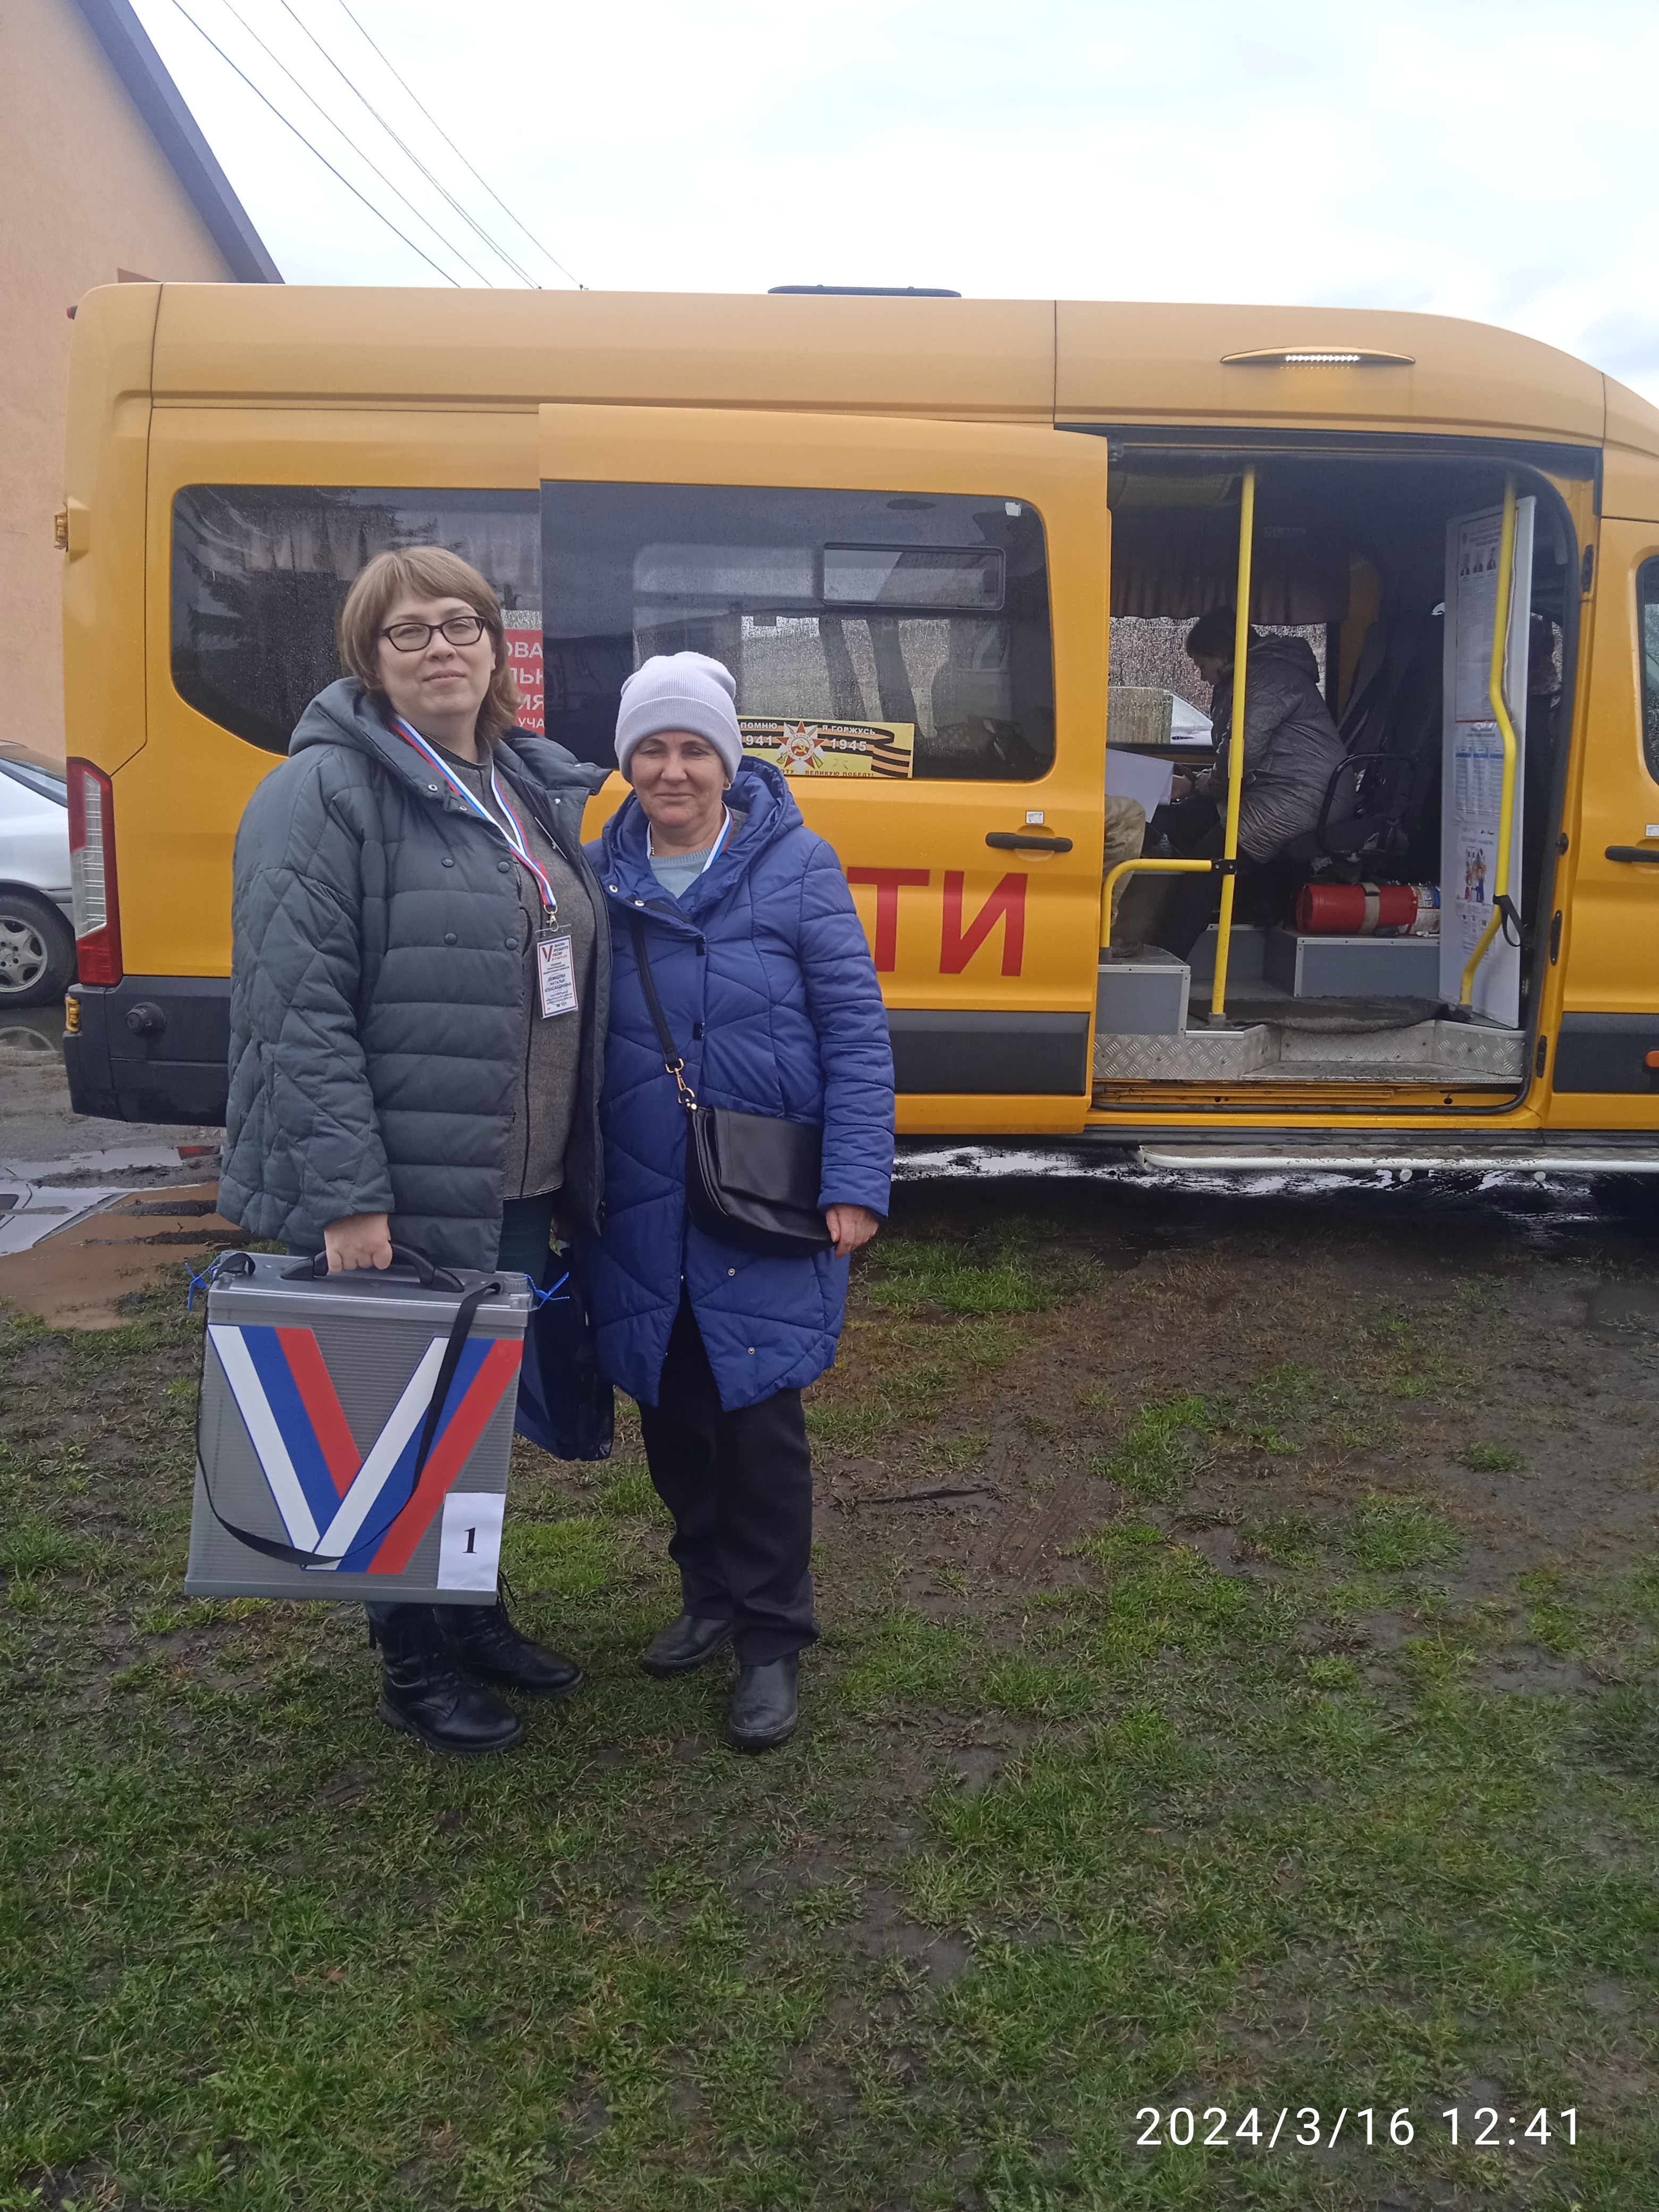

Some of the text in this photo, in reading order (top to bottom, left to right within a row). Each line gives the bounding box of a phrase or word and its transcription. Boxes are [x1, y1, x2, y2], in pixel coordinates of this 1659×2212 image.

[831, 725, 876, 736] ГОРЖУСЬ
[745, 735, 867, 751] 941 1945
[847, 867, 1028, 977] ТИ
[463, 1527, 478, 1554] 1
